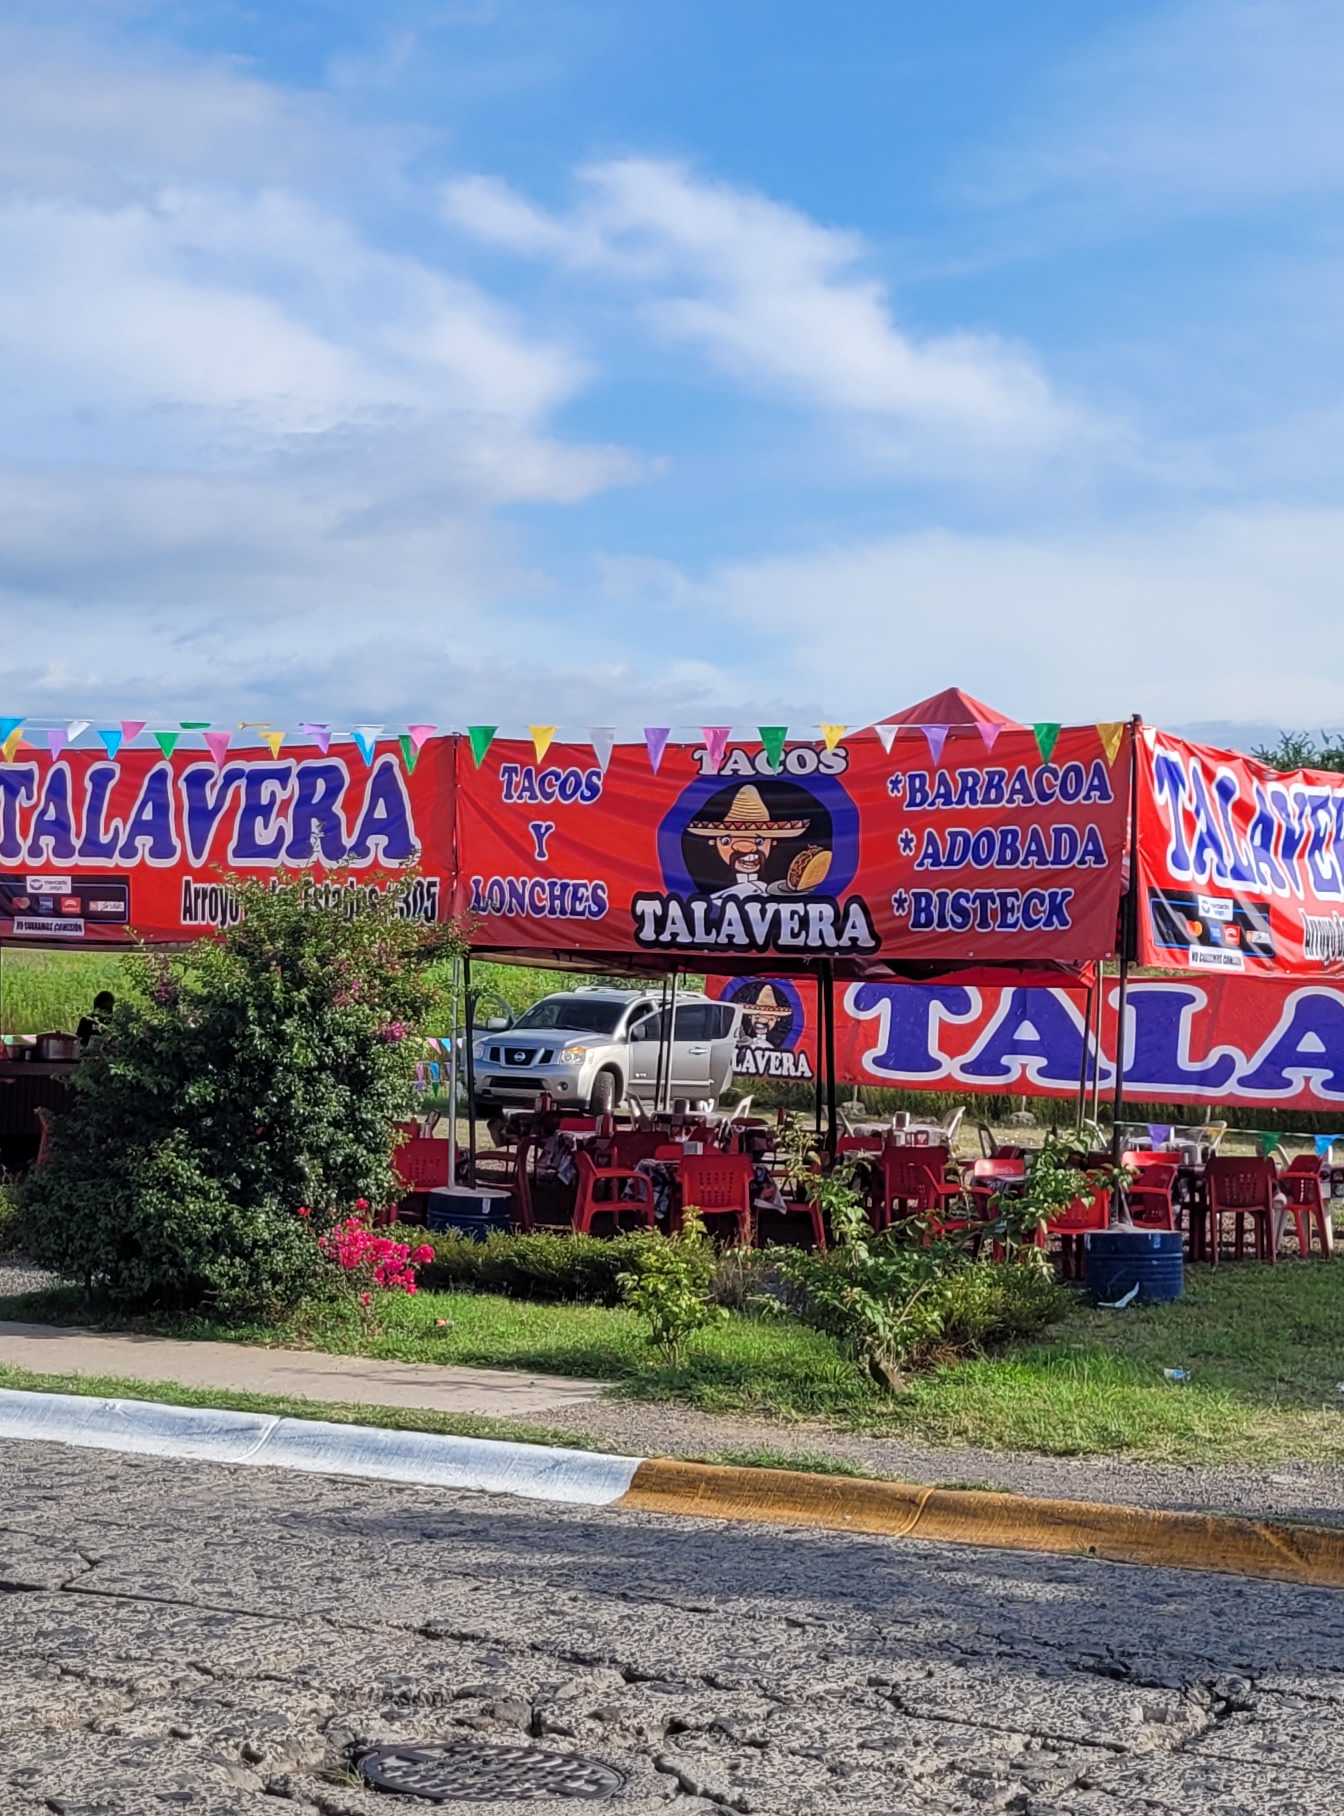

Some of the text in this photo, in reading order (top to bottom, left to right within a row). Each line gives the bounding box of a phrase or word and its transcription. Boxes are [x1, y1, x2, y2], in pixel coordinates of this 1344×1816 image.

[693, 747, 848, 776] TACOS
[500, 763, 603, 804] TACOS
[529, 822, 555, 861] Y
[470, 877, 608, 921] LONCHES
[635, 898, 876, 947] TALAVERA
[731, 1046, 813, 1077] LAVERA
